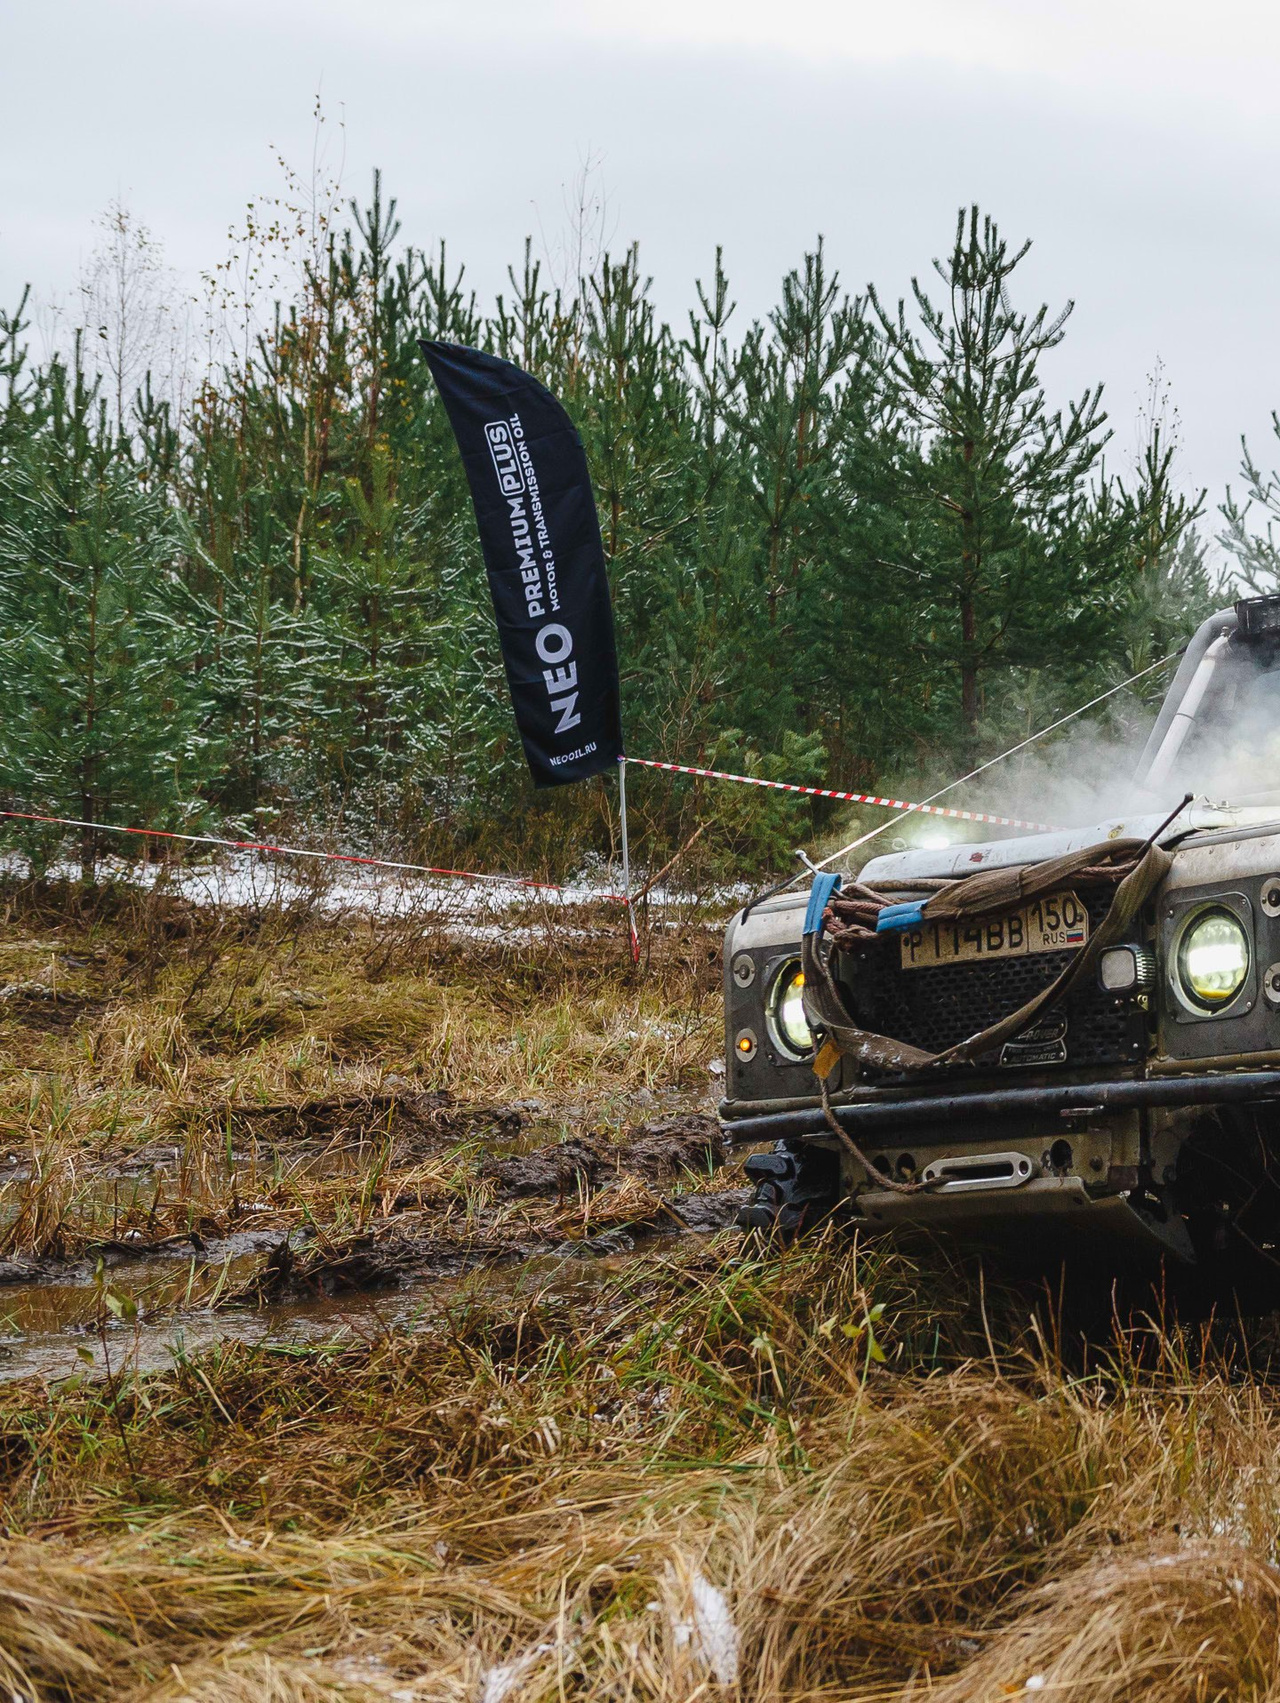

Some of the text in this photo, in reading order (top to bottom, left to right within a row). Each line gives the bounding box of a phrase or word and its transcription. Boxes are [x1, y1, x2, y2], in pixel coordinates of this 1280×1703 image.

[510, 412, 524, 439] OIL
[517, 441, 551, 549] TRANSMISSION
[489, 426, 546, 619] PREMIUM PLUS
[545, 560, 561, 611] MOTOR
[535, 622, 582, 734] NEO
[550, 741, 597, 767] NEOOIL.RU
[1029, 896, 1078, 934] 150
[1042, 931, 1066, 946] RUS
[1010, 1052, 1056, 1063] AUTOMATIC
